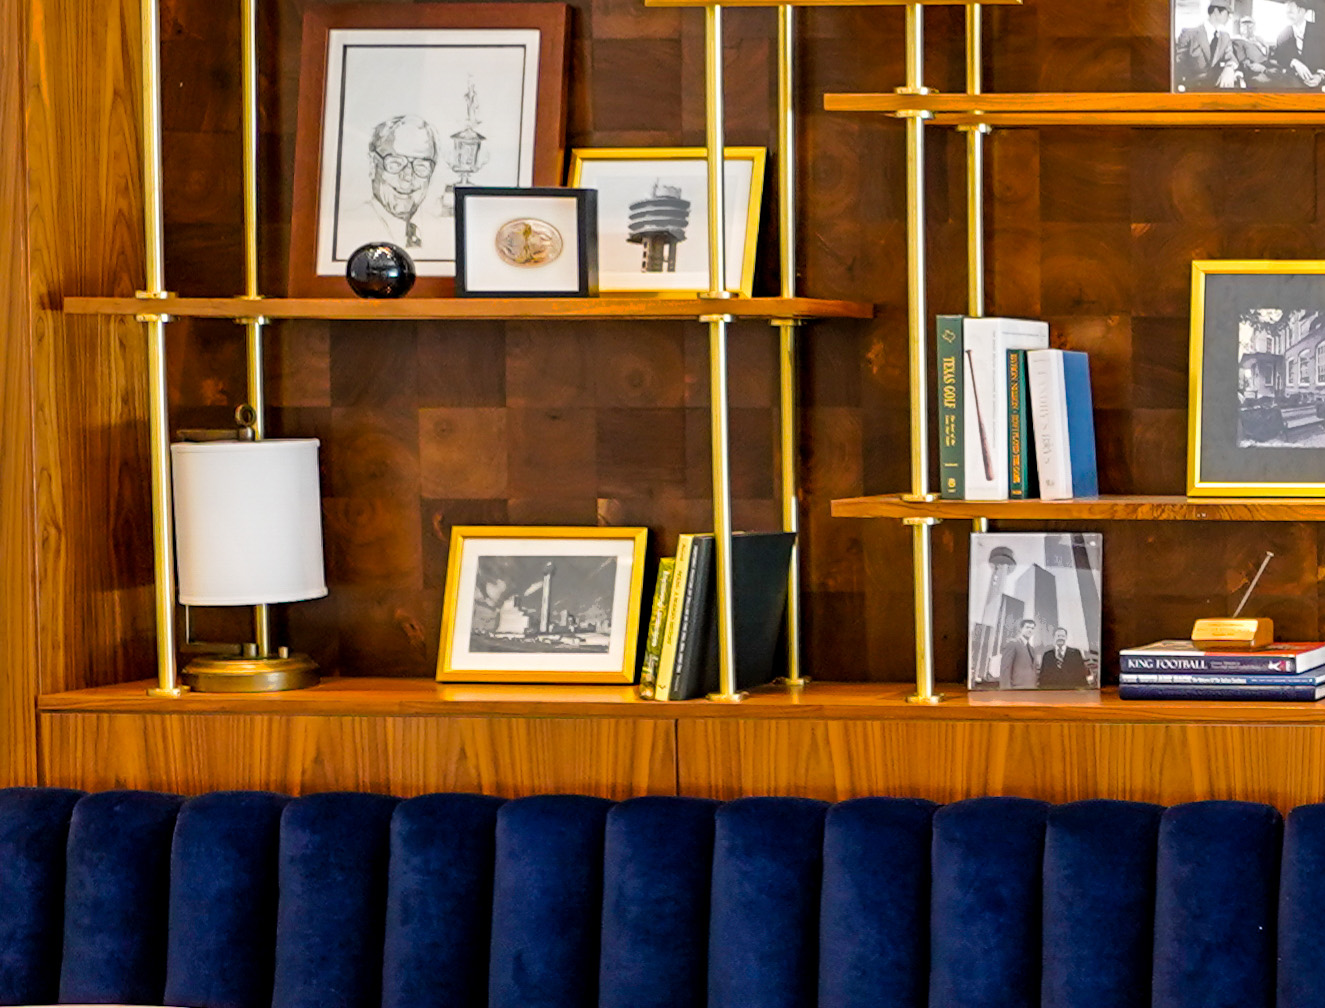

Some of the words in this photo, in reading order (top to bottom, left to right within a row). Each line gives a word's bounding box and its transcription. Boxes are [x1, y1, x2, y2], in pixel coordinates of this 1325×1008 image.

[942, 356, 956, 384] TEXAS
[943, 385, 956, 409] GOLF
[1127, 659, 1153, 669] KING
[1156, 659, 1209, 670] FOOTBALL
